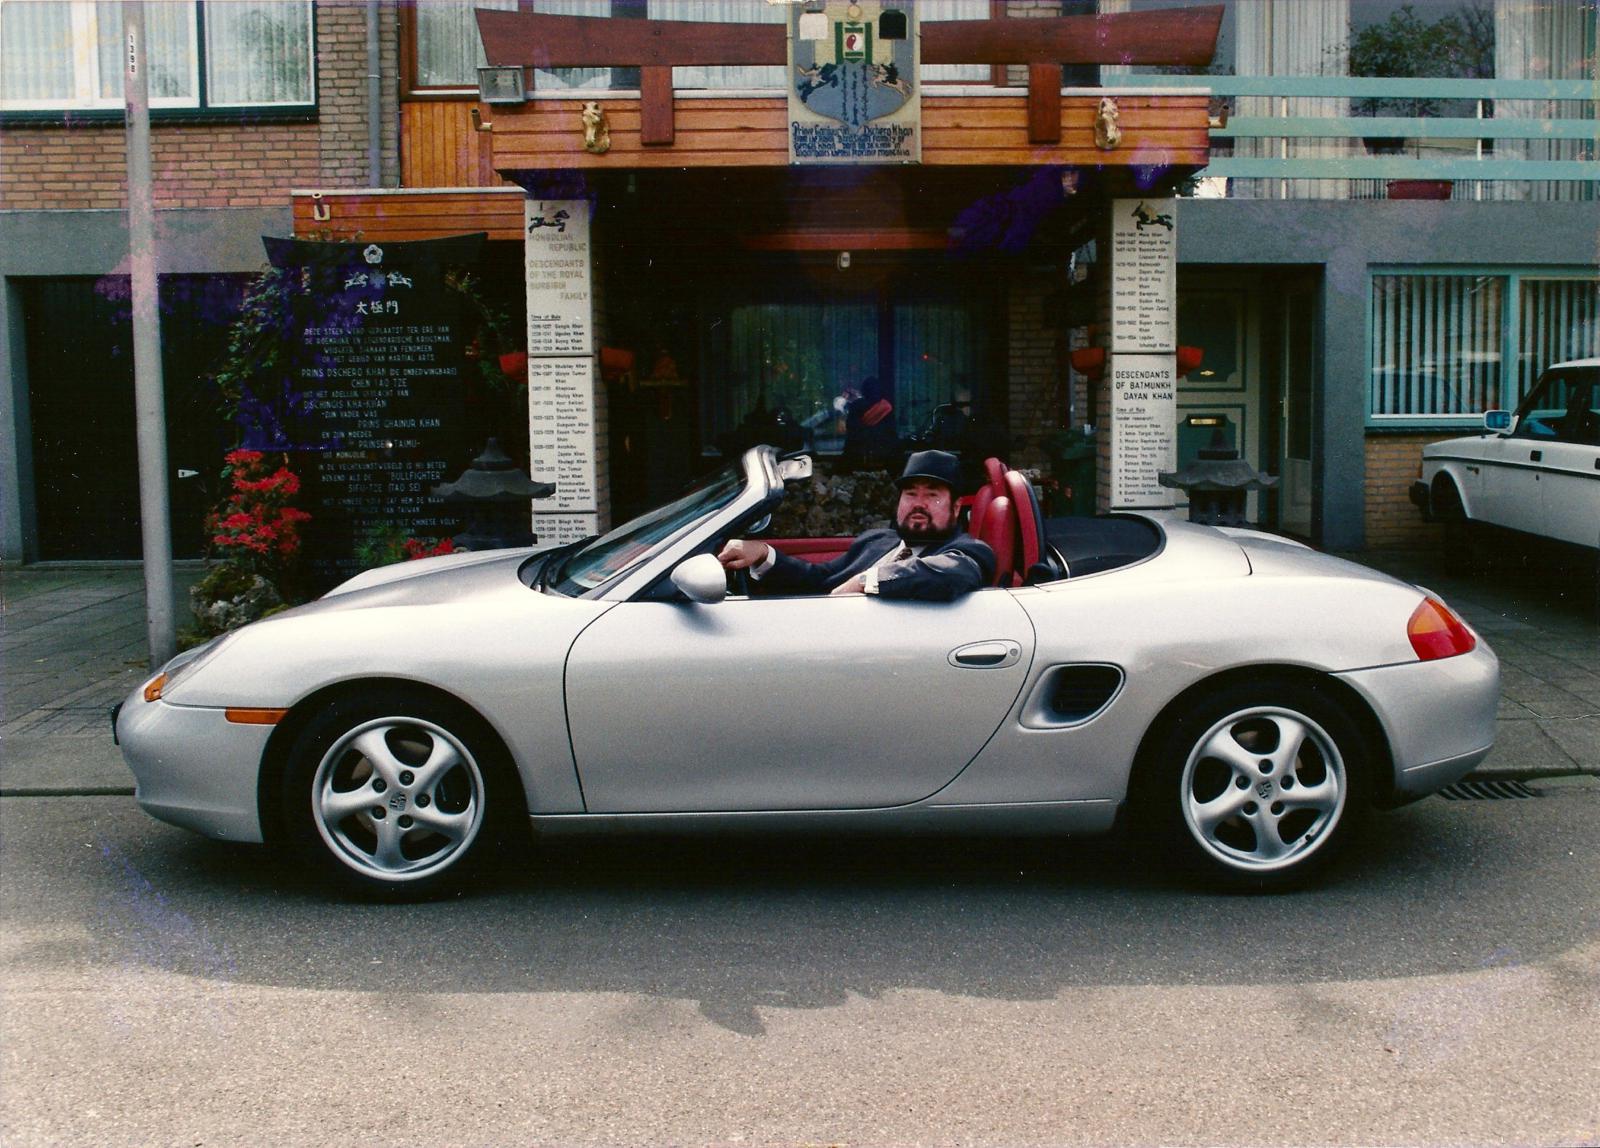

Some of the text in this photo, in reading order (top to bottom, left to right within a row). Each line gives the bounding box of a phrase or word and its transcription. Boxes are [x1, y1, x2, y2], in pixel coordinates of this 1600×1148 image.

[549, 243, 587, 251] REPUBLIC
[530, 260, 584, 268] DESCENDANTS
[530, 271, 538, 279] OF
[542, 271, 557, 279] THE
[560, 292, 588, 300] FAMILY
[437, 325, 450, 333] VAN
[388, 353, 415, 361] MARTIAL
[301, 368, 324, 377] PRINS
[327, 368, 363, 377] DSCHERO
[366, 368, 387, 376] KHAN
[1115, 371, 1169, 379] DESCENDANTS
[351, 379, 372, 388] CHEN
[393, 378, 408, 387] TZE
[1115, 382, 1125, 390] OF
[1123, 392, 1173, 400] DAYAN KHAN
[419, 418, 441, 428] KHAN
[427, 461, 447, 469] BETER
[411, 518, 436, 526] CHINESE
